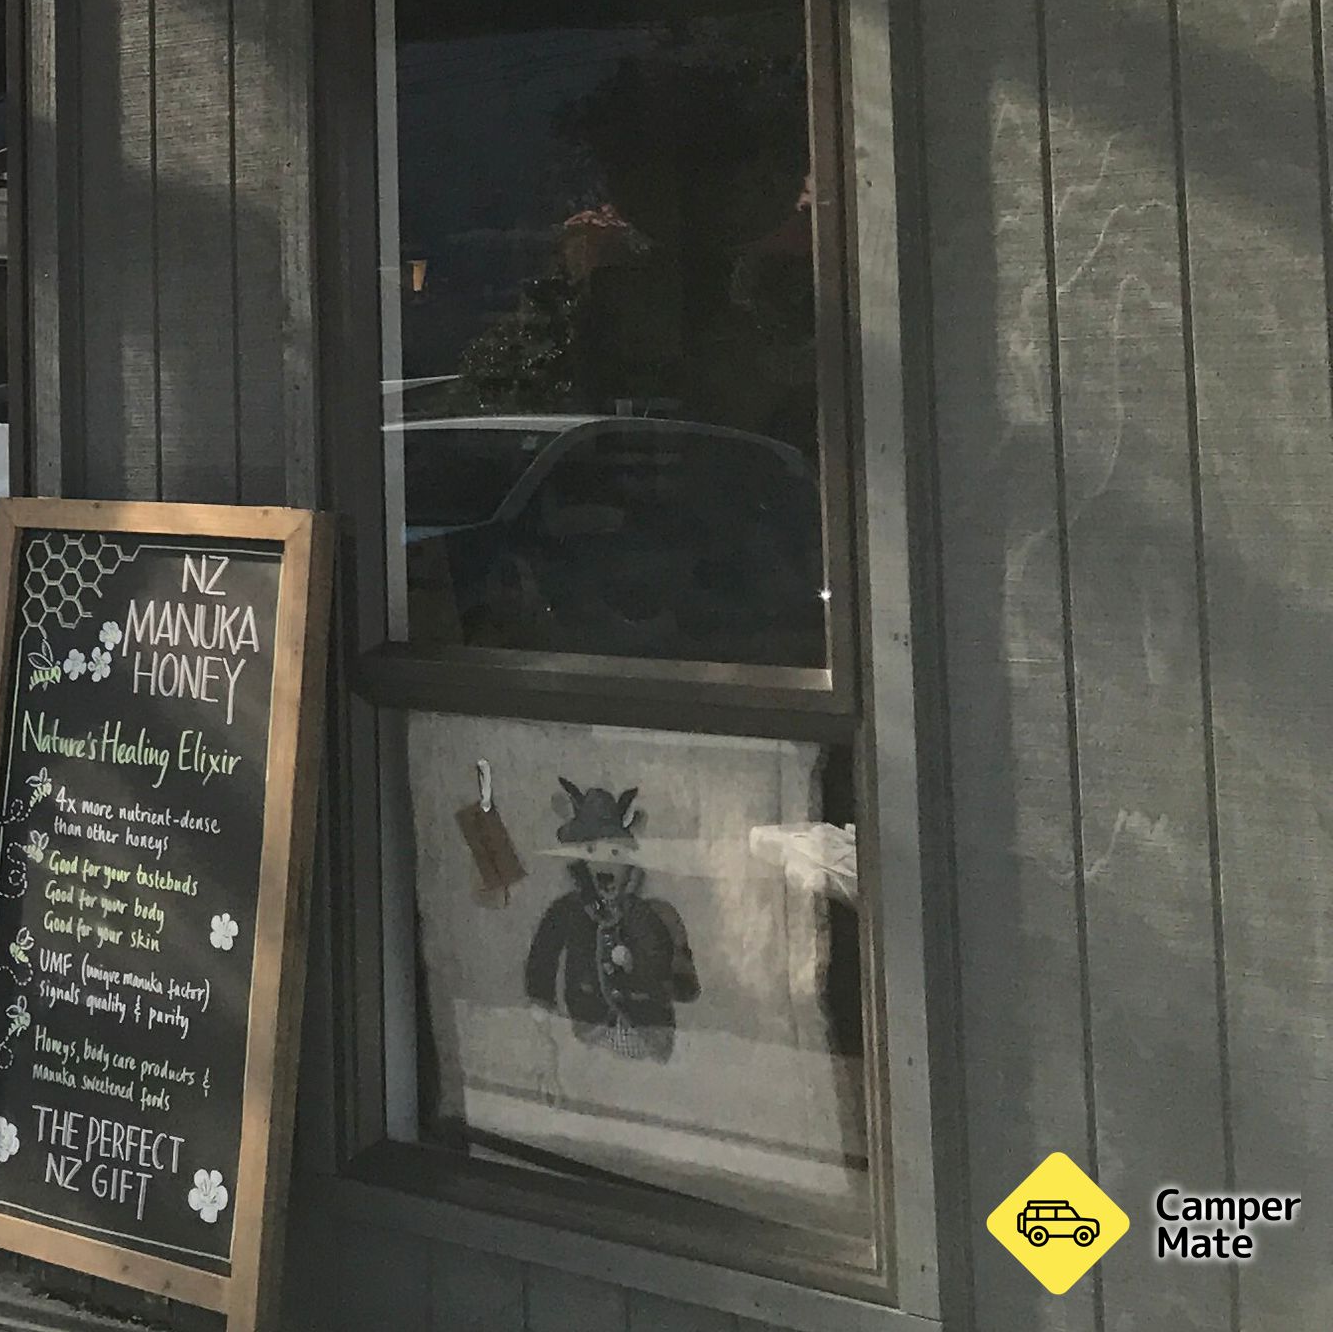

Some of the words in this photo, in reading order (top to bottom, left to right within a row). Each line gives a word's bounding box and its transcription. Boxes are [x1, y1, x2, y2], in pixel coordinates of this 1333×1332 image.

[182, 553, 230, 596] NZ
[121, 599, 260, 657] MANUKA
[133, 651, 246, 725] HONEY
[22, 710, 97, 760] Nature's
[101, 721, 170, 788] Healing
[178, 730, 242, 786] Elixir
[54, 816, 82, 836] than
[86, 823, 119, 844] other
[125, 826, 169, 860] honeys
[55, 786, 77, 814] 4x
[82, 800, 114, 820] more
[119, 803, 221, 835] nutrient-dense
[48, 850, 79, 875] Good
[83, 858, 102, 883] for
[103, 865, 131, 889] your
[136, 863, 199, 896] tastebuds
[43, 910, 73, 933] Good
[76, 917, 93, 943] for
[96, 925, 123, 948] your
[130, 929, 160, 953] skin
[44, 879, 74, 905] Good
[78, 888, 98, 910] for
[100, 897, 128, 918] your
[133, 897, 165, 934] body
[39, 947, 73, 977] UMF
[81, 952, 120, 990] (unique
[122, 971, 163, 994] manuka
[167, 978, 210, 1012] factor)
[39, 979, 81, 1008] signals
[86, 992, 126, 1023] quality
[148, 1005, 189, 1040] purity
[35, 1024, 80, 1065] Honeys,
[83, 1037, 110, 1072] body
[112, 1053, 136, 1070] care
[140, 1060, 196, 1086] products
[81, 1075, 134, 1102] sweetened
[140, 1086, 170, 1112] foods
[32, 1104, 84, 1150] THE
[86, 1116, 185, 1173] PERFECT
[44, 1152, 81, 1192] NZ
[91, 1163, 153, 1220] GIFT
